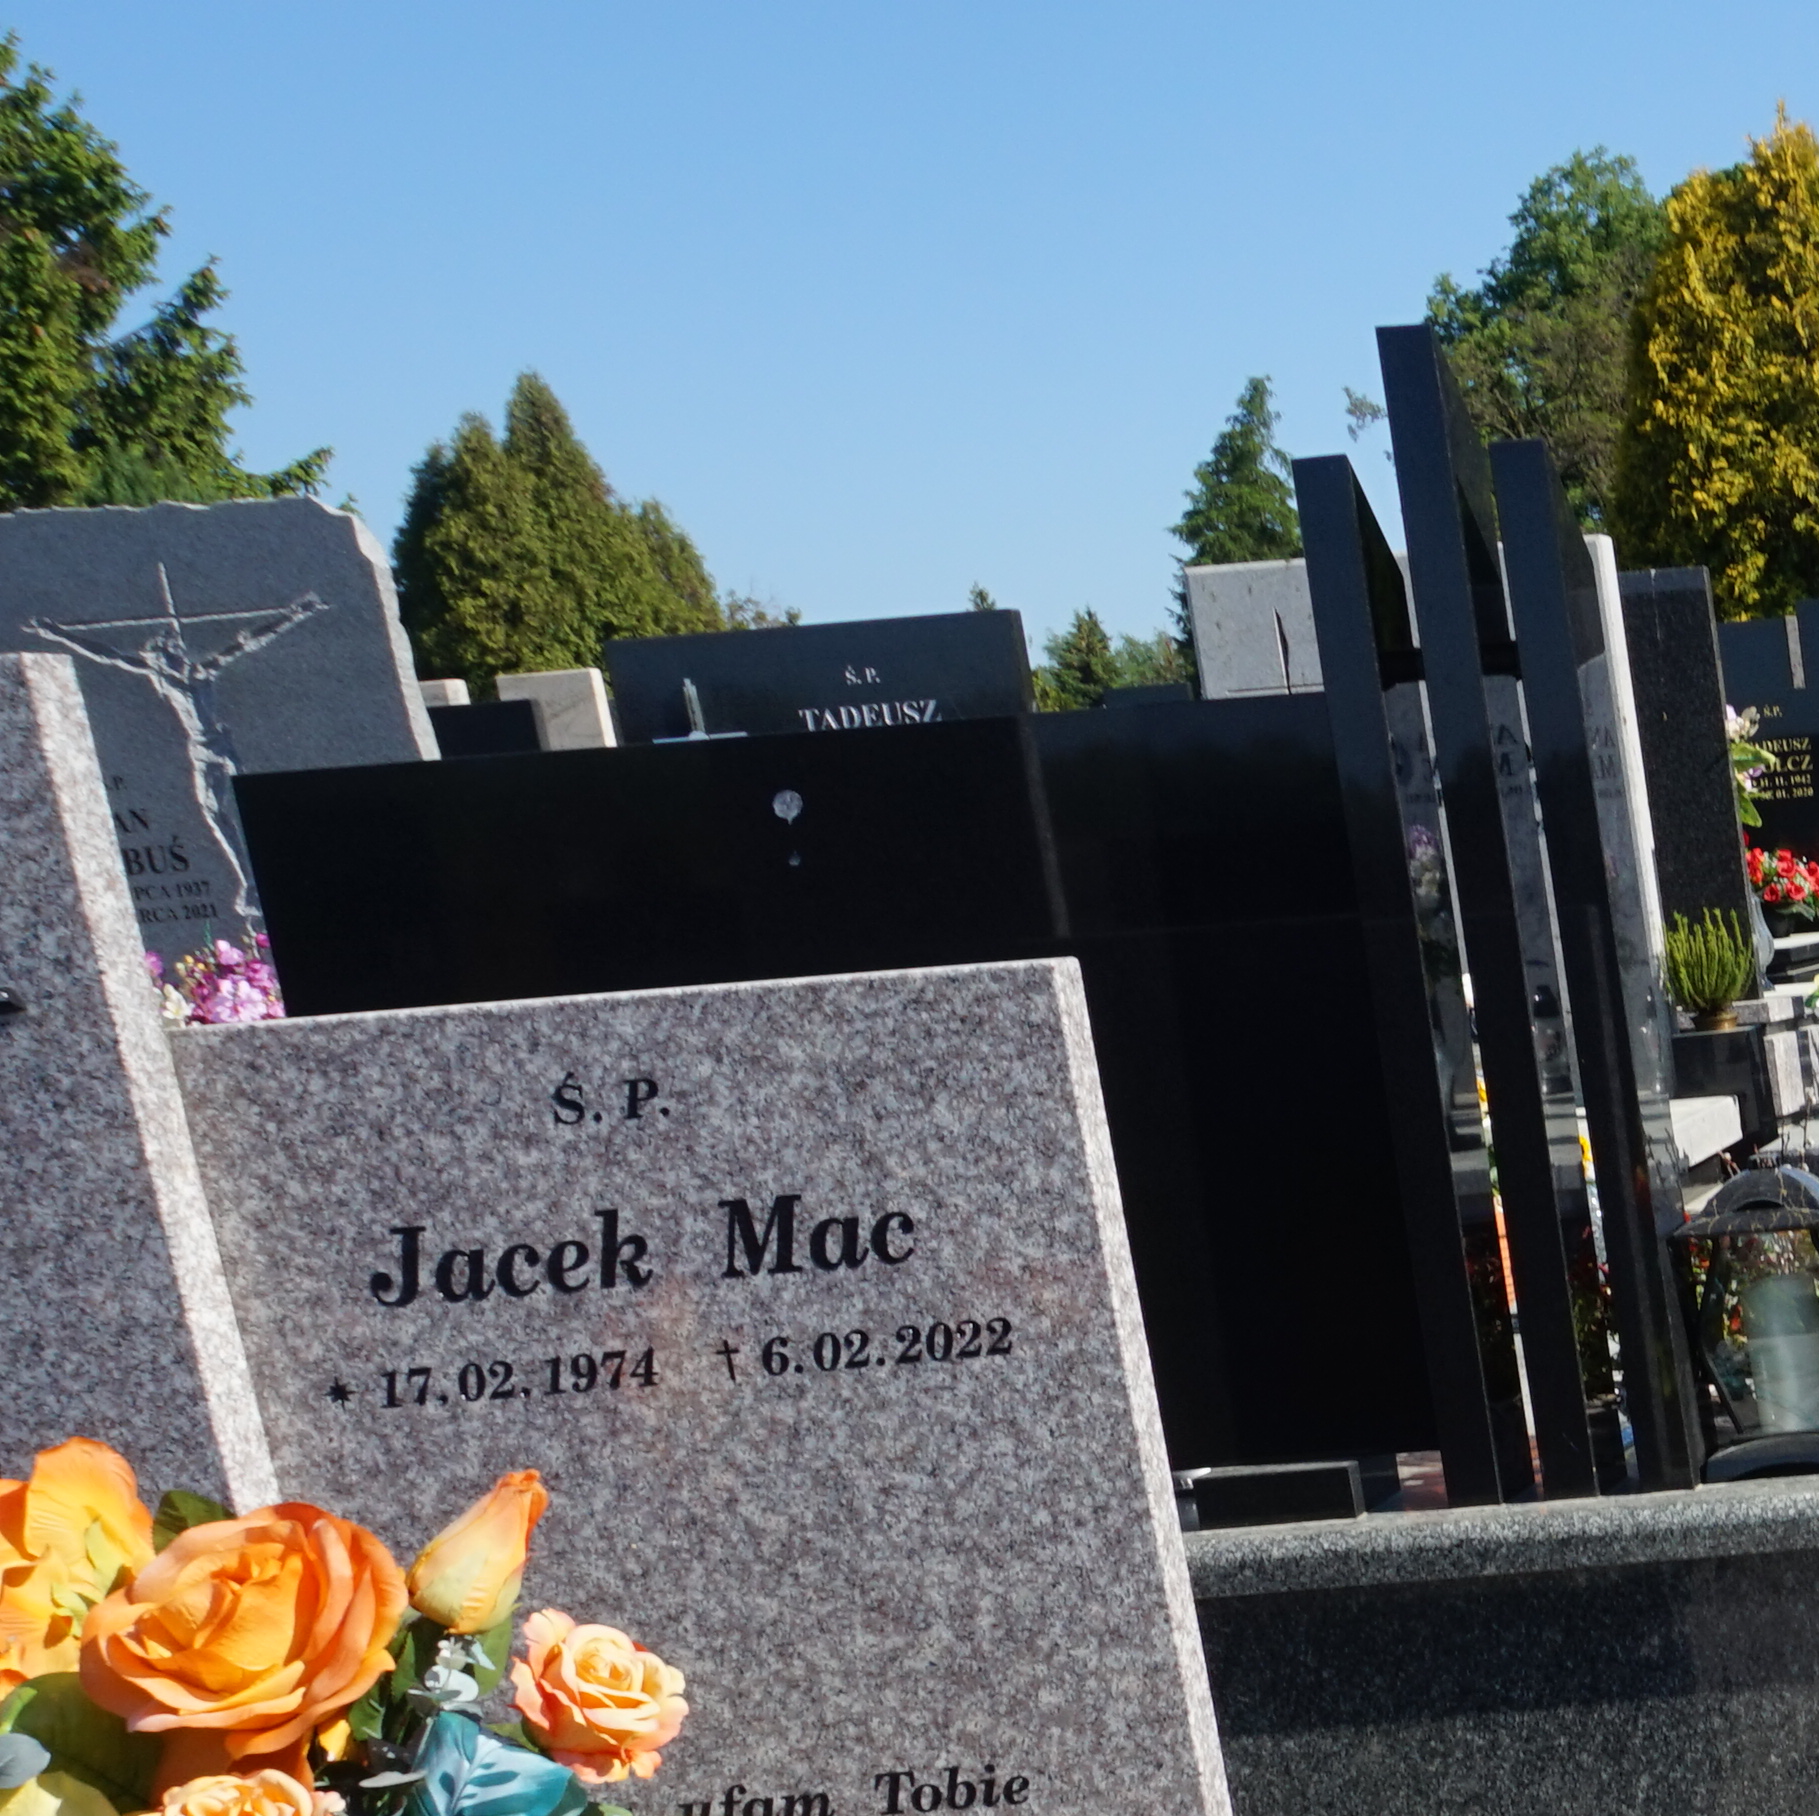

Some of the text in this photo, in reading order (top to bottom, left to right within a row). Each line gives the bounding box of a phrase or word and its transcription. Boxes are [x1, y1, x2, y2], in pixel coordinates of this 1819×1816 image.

[798, 699, 943, 732] TADEUSZ
[1751, 737, 1812, 753] DEUSZ
[115, 808, 150, 834] AN
[122, 835, 190, 876] BUŚ
[133, 884, 171, 901] PCA
[139, 907, 179, 923] RCA
[370, 1194, 915, 1307] Jacek Mac
[874, 1764, 1030, 1816] Tobie
